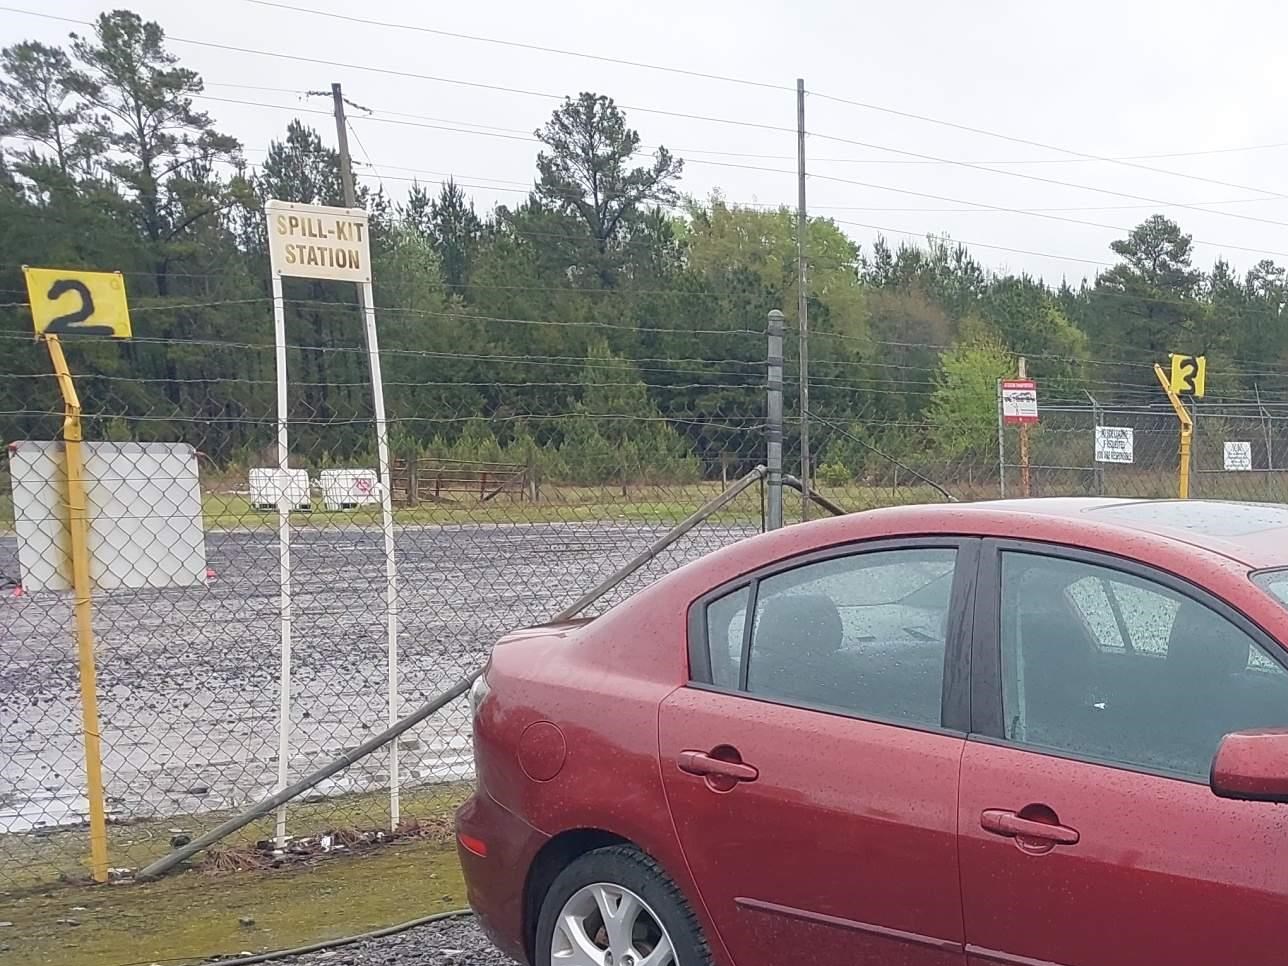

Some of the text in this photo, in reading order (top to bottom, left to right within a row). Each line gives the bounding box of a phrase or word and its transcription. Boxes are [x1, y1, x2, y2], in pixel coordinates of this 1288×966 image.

[277, 215, 364, 242] SPILL-KIT
[285, 244, 360, 270] STATION
[46, 279, 114, 336] 2
[1178, 357, 1199, 395] 3
